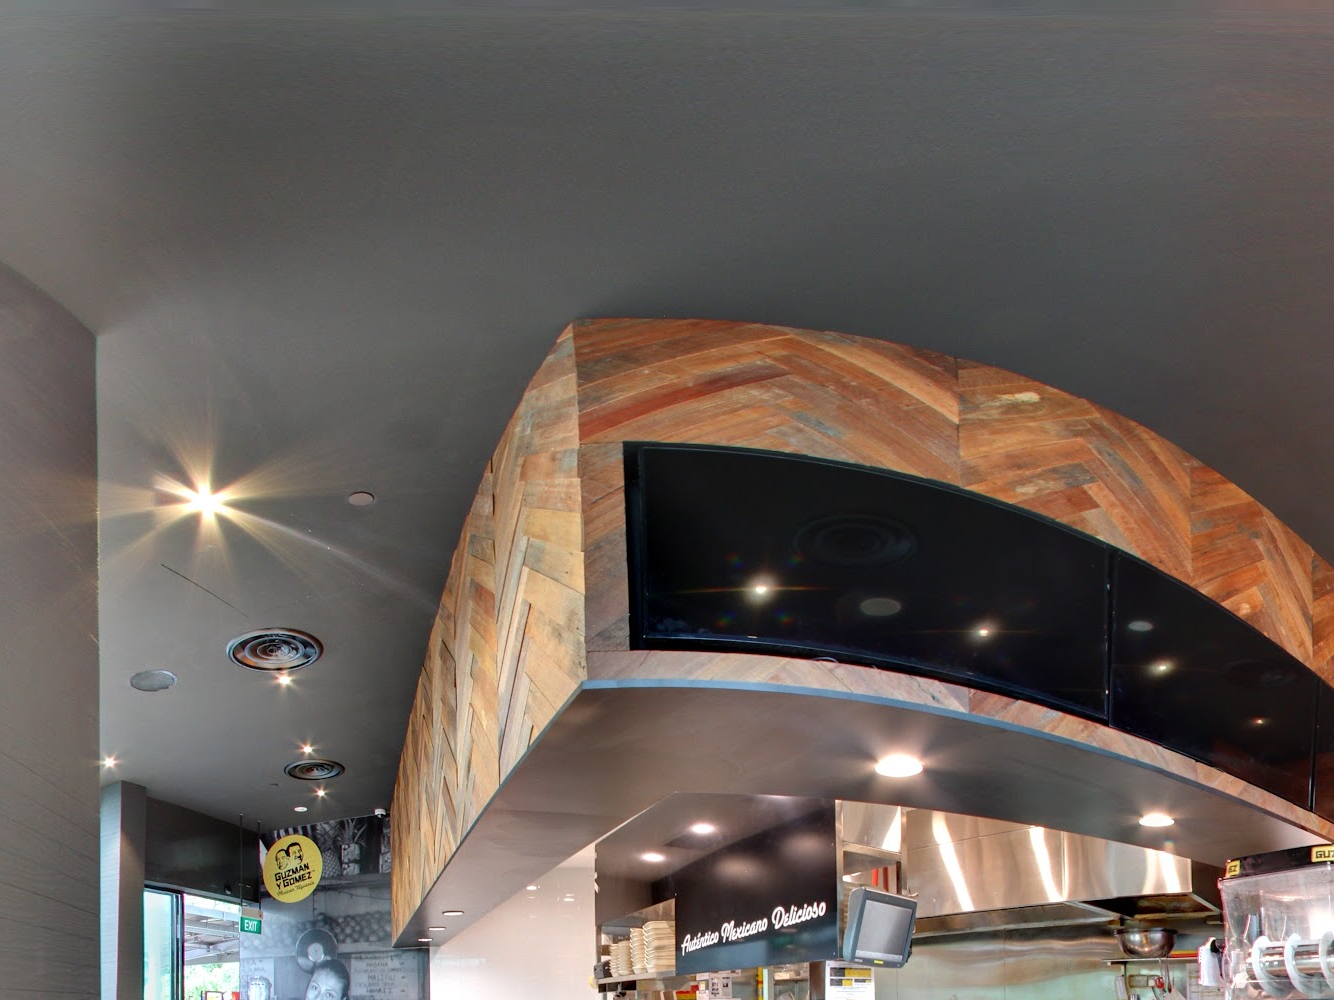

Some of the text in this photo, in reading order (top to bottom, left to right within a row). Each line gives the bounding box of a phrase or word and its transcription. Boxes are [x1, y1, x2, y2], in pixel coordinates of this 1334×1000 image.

[275, 863, 310, 882] GUZMAN
[276, 872, 312, 890] Y GOMEZ
[244, 919, 257, 932] EXIT
[721, 920, 768, 943] Mexicano
[771, 902, 826, 930] Delicioso
